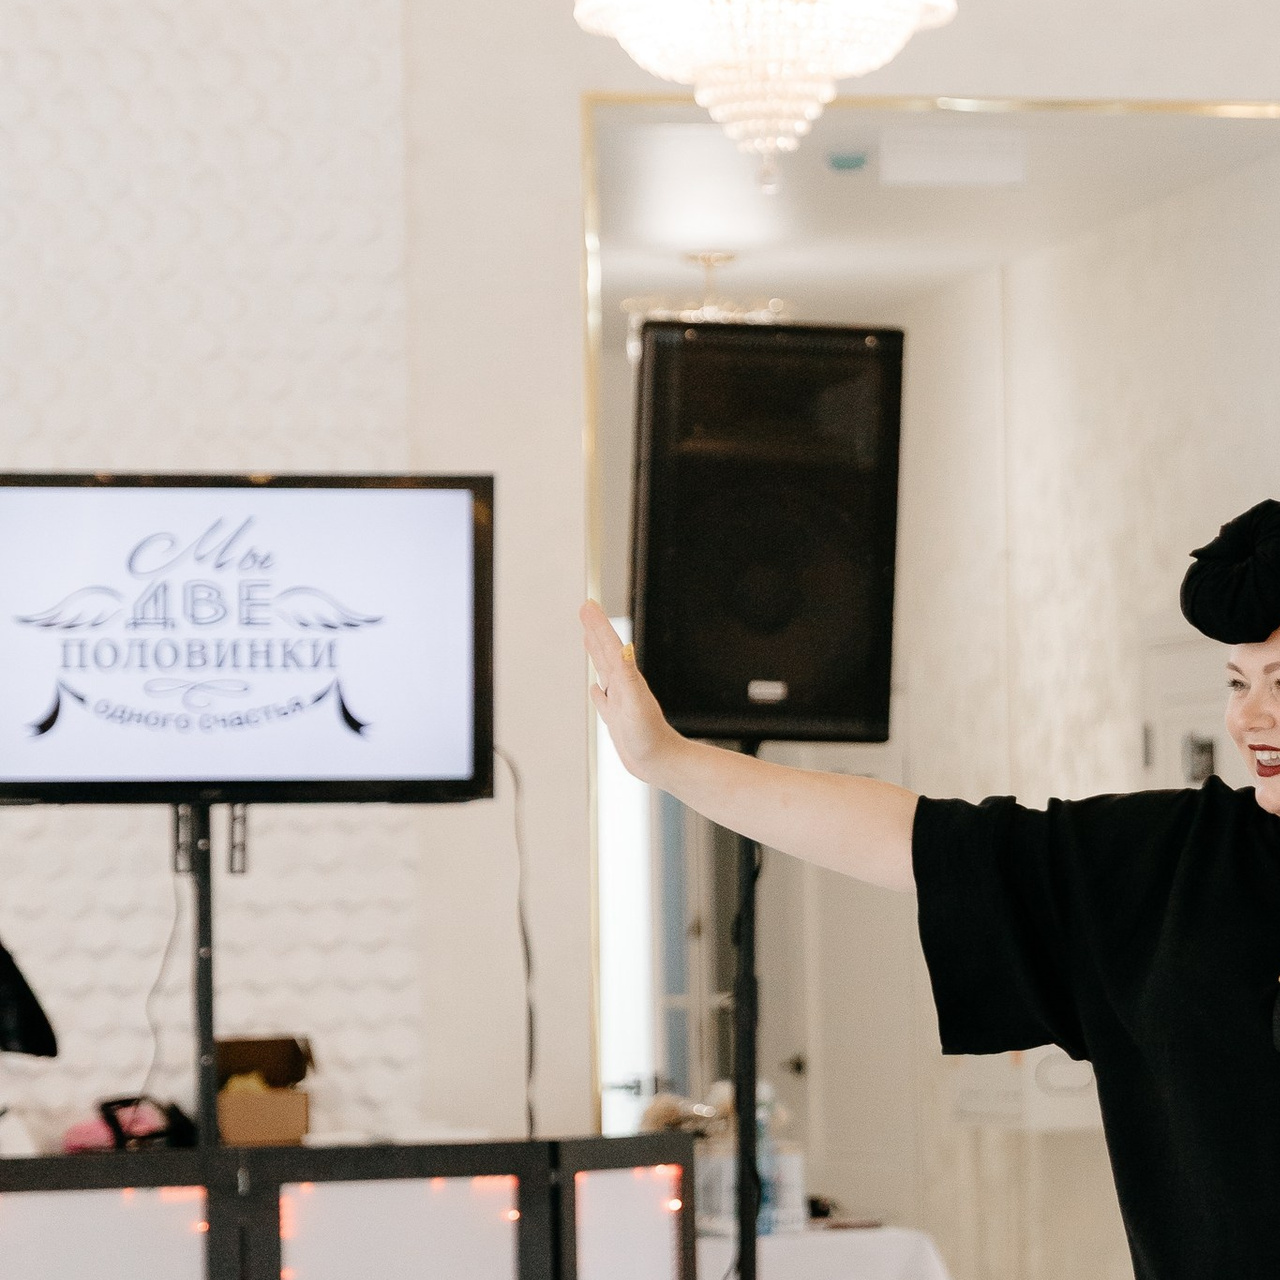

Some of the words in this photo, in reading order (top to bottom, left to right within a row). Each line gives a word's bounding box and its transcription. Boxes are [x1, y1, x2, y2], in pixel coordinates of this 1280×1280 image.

[126, 516, 274, 576] Мы
[126, 579, 272, 630] ДВЕ
[60, 637, 337, 671] ПОЛОВИНКИ
[95, 698, 190, 731] одного
